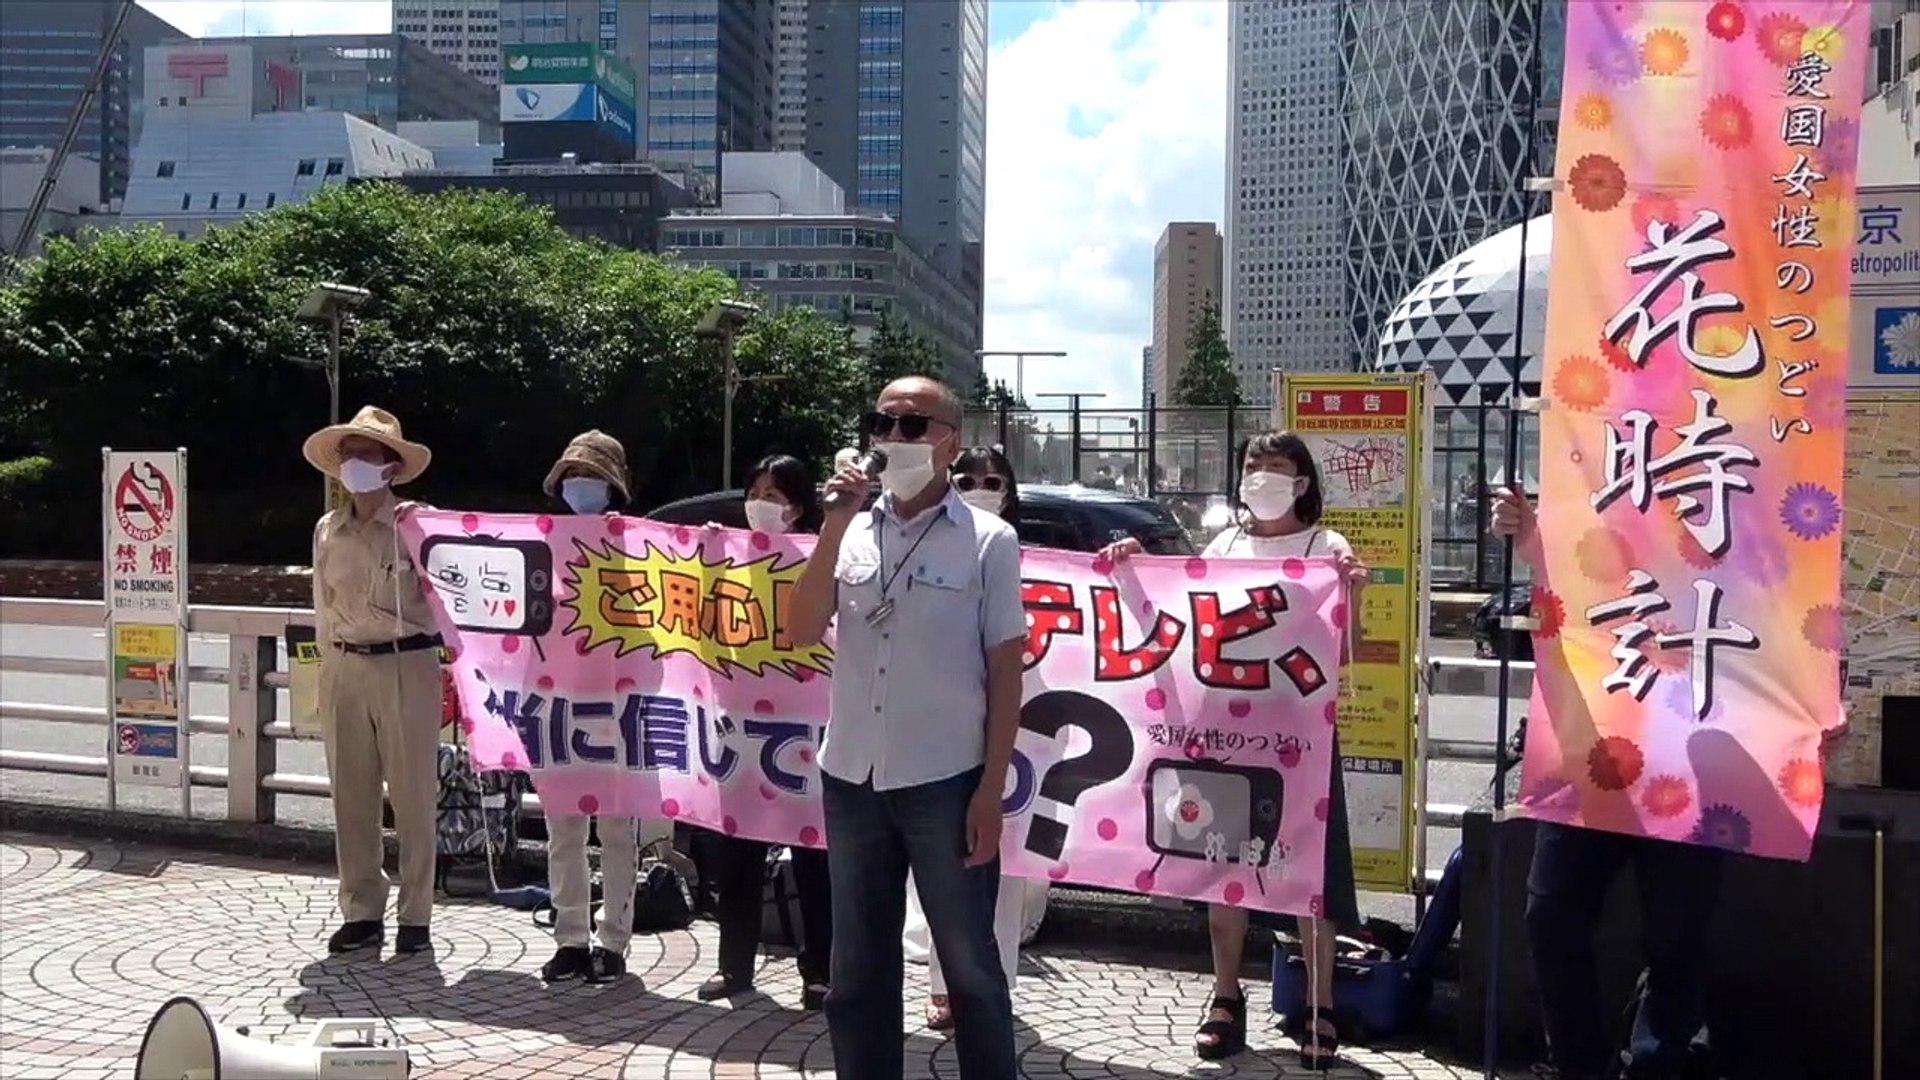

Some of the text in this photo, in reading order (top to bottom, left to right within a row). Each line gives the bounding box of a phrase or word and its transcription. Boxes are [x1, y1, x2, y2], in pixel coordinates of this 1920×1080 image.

[1770, 51, 1832, 443] 愛国女性のつどい
[1585, 207, 1767, 723] 花時計
[114, 543, 173, 575] 禁煙
[114, 579, 174, 592] NO SMOKING
[1146, 723, 1312, 754] 愛国女性のつどい
